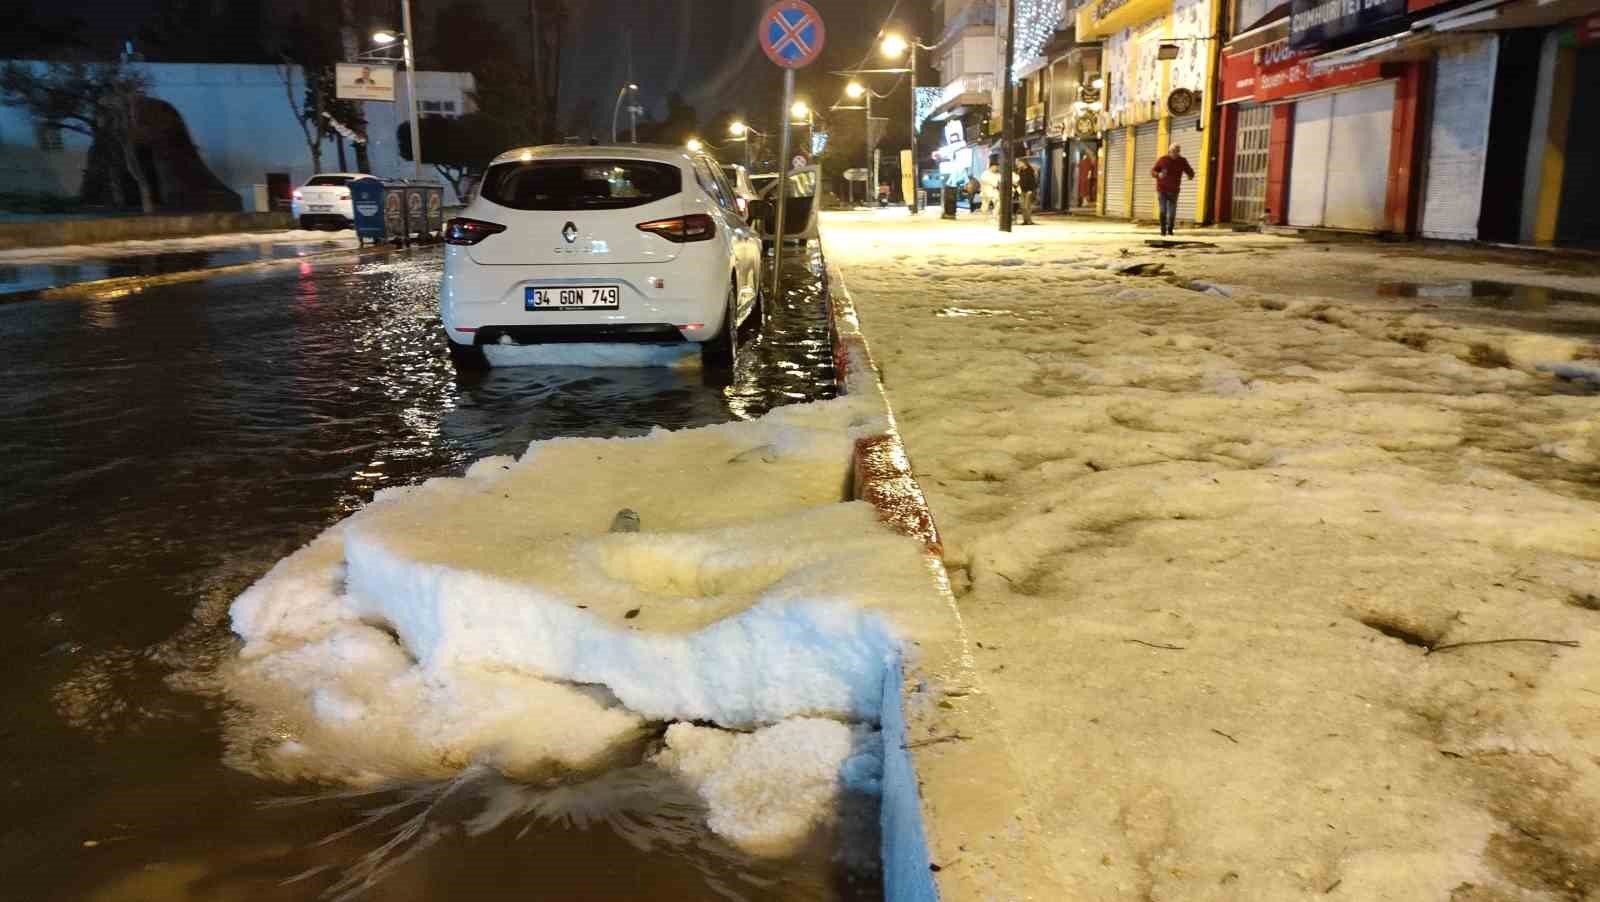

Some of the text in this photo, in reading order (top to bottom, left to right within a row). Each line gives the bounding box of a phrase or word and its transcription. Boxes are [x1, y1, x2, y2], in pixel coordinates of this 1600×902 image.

[534, 289, 616, 305] 34 GDN 749
